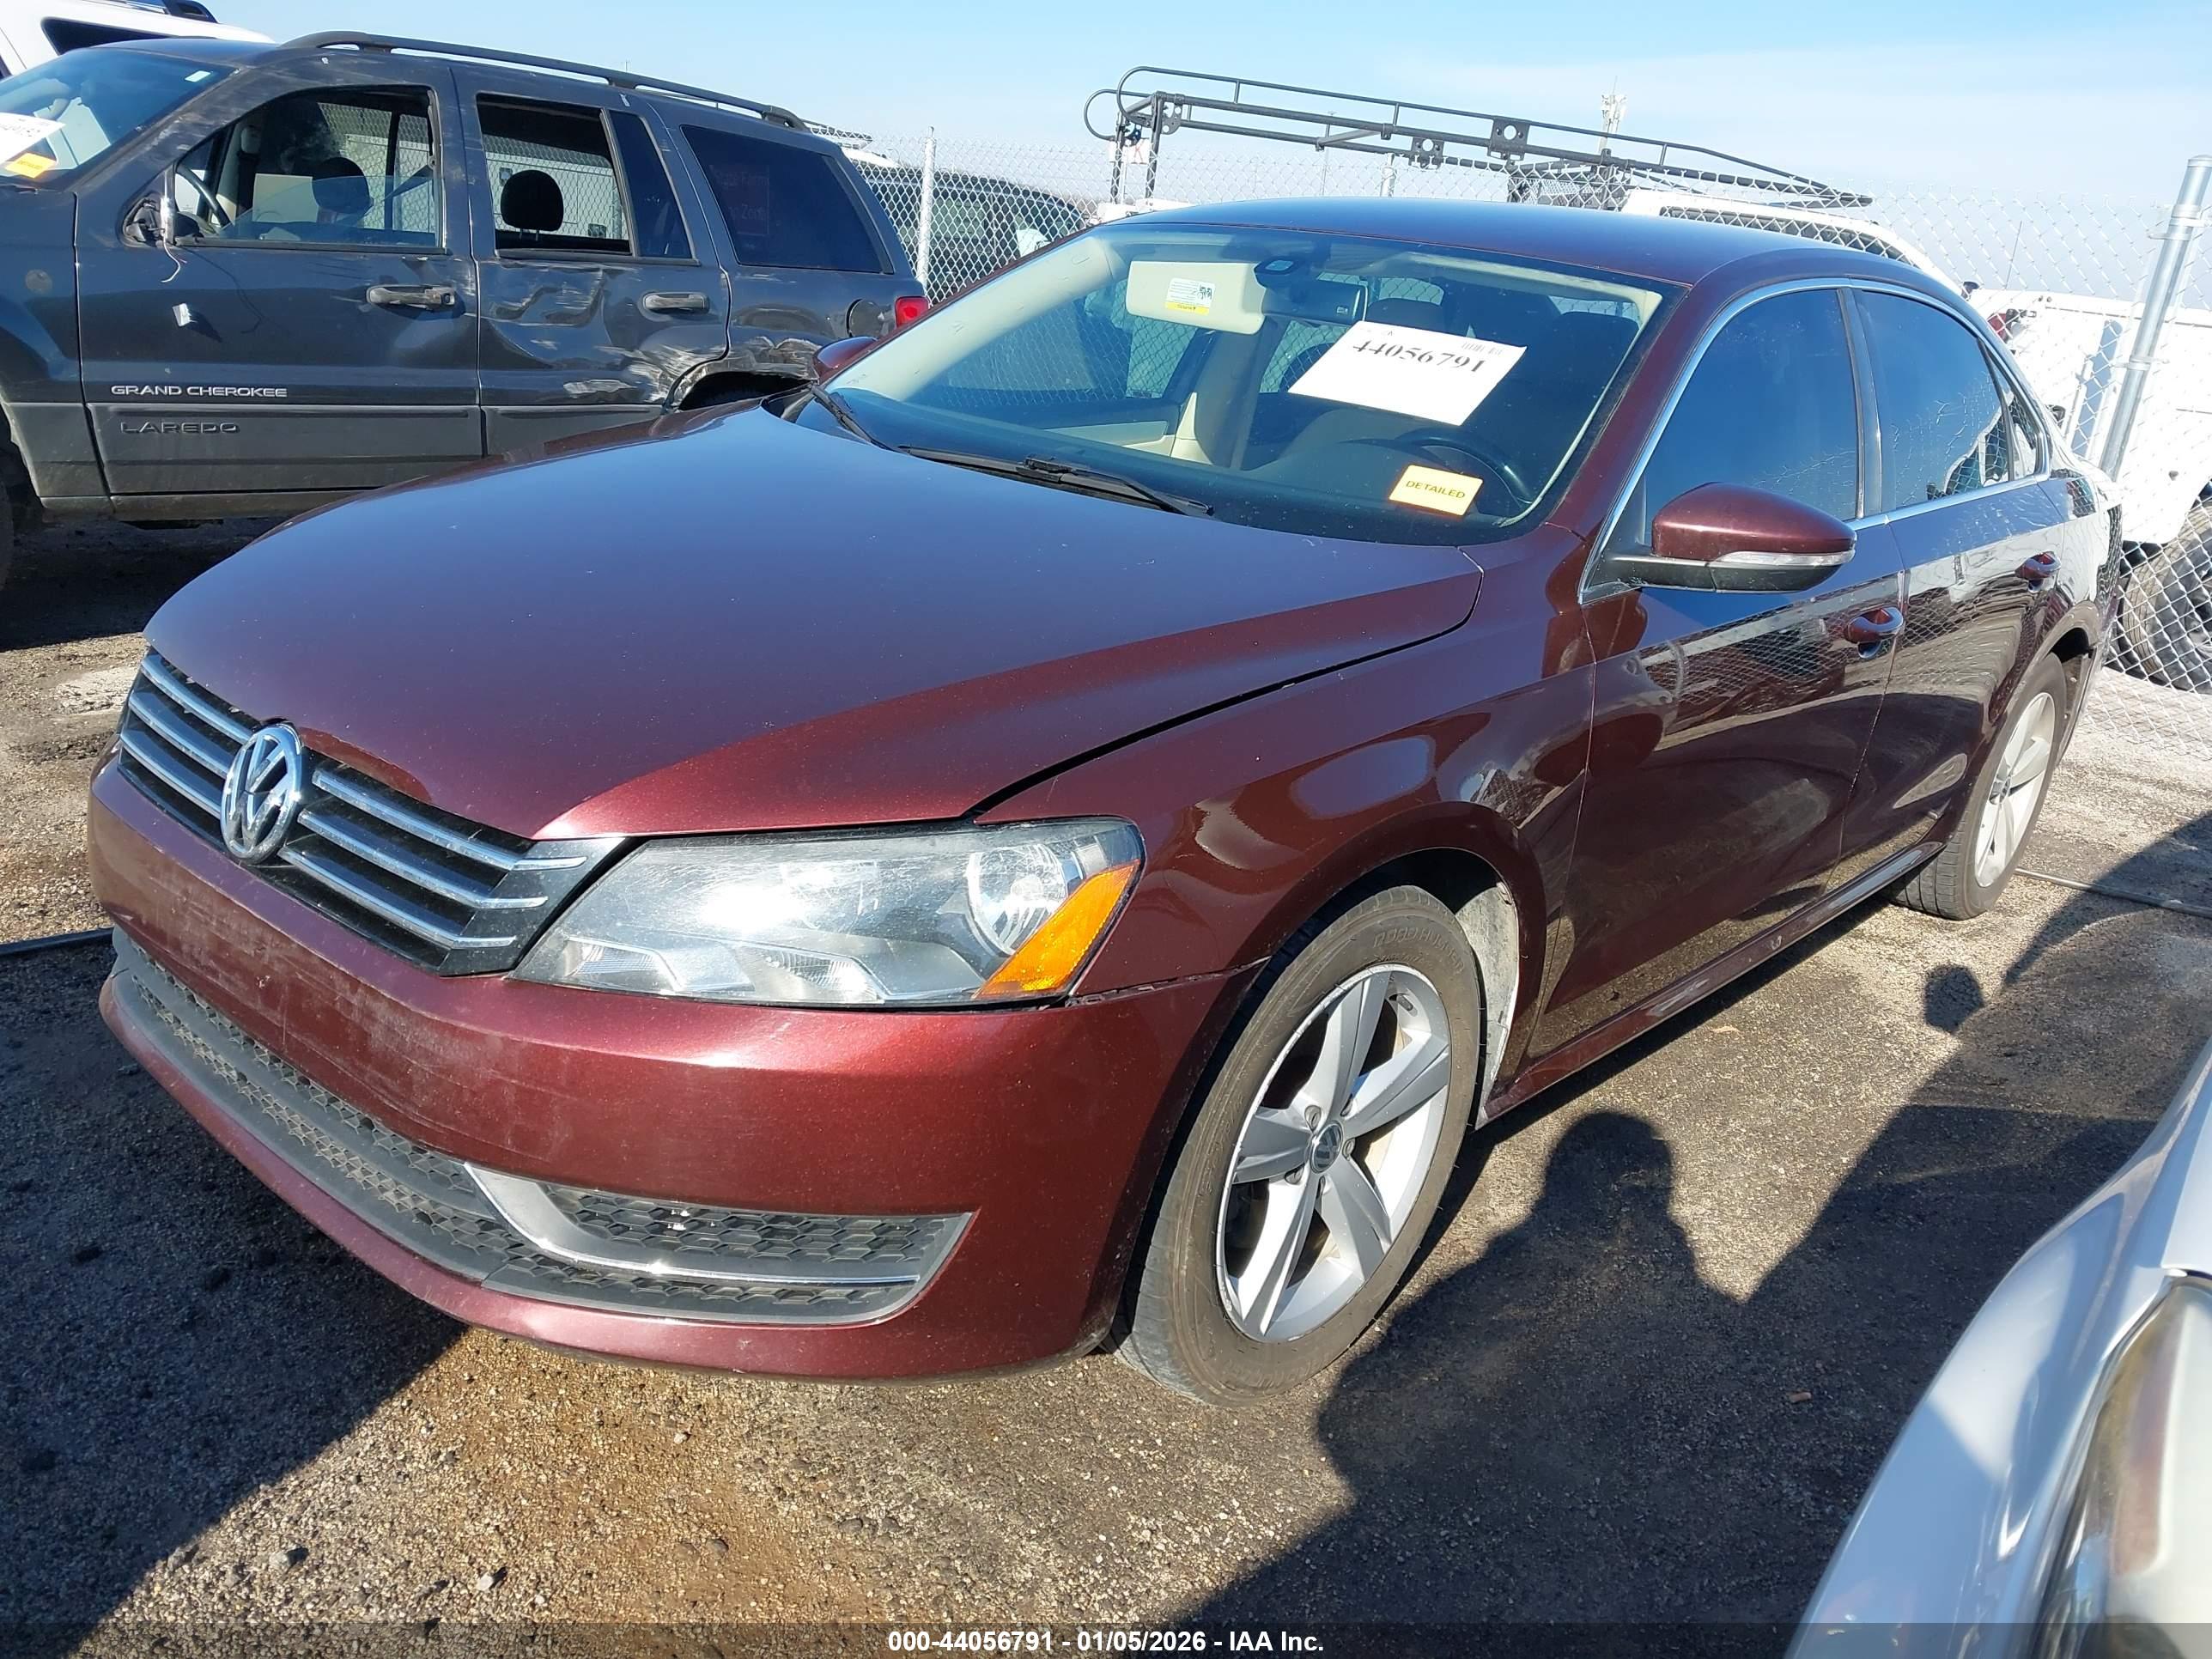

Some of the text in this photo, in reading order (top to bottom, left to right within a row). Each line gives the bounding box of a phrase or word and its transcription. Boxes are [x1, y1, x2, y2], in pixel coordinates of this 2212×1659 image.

[1352, 340, 1486, 372] 44056791
[111, 385, 288, 398] GRAND CHEROKEE
[120, 422, 241, 434] LAREDO
[1406, 480, 1466, 499] DETAILED
